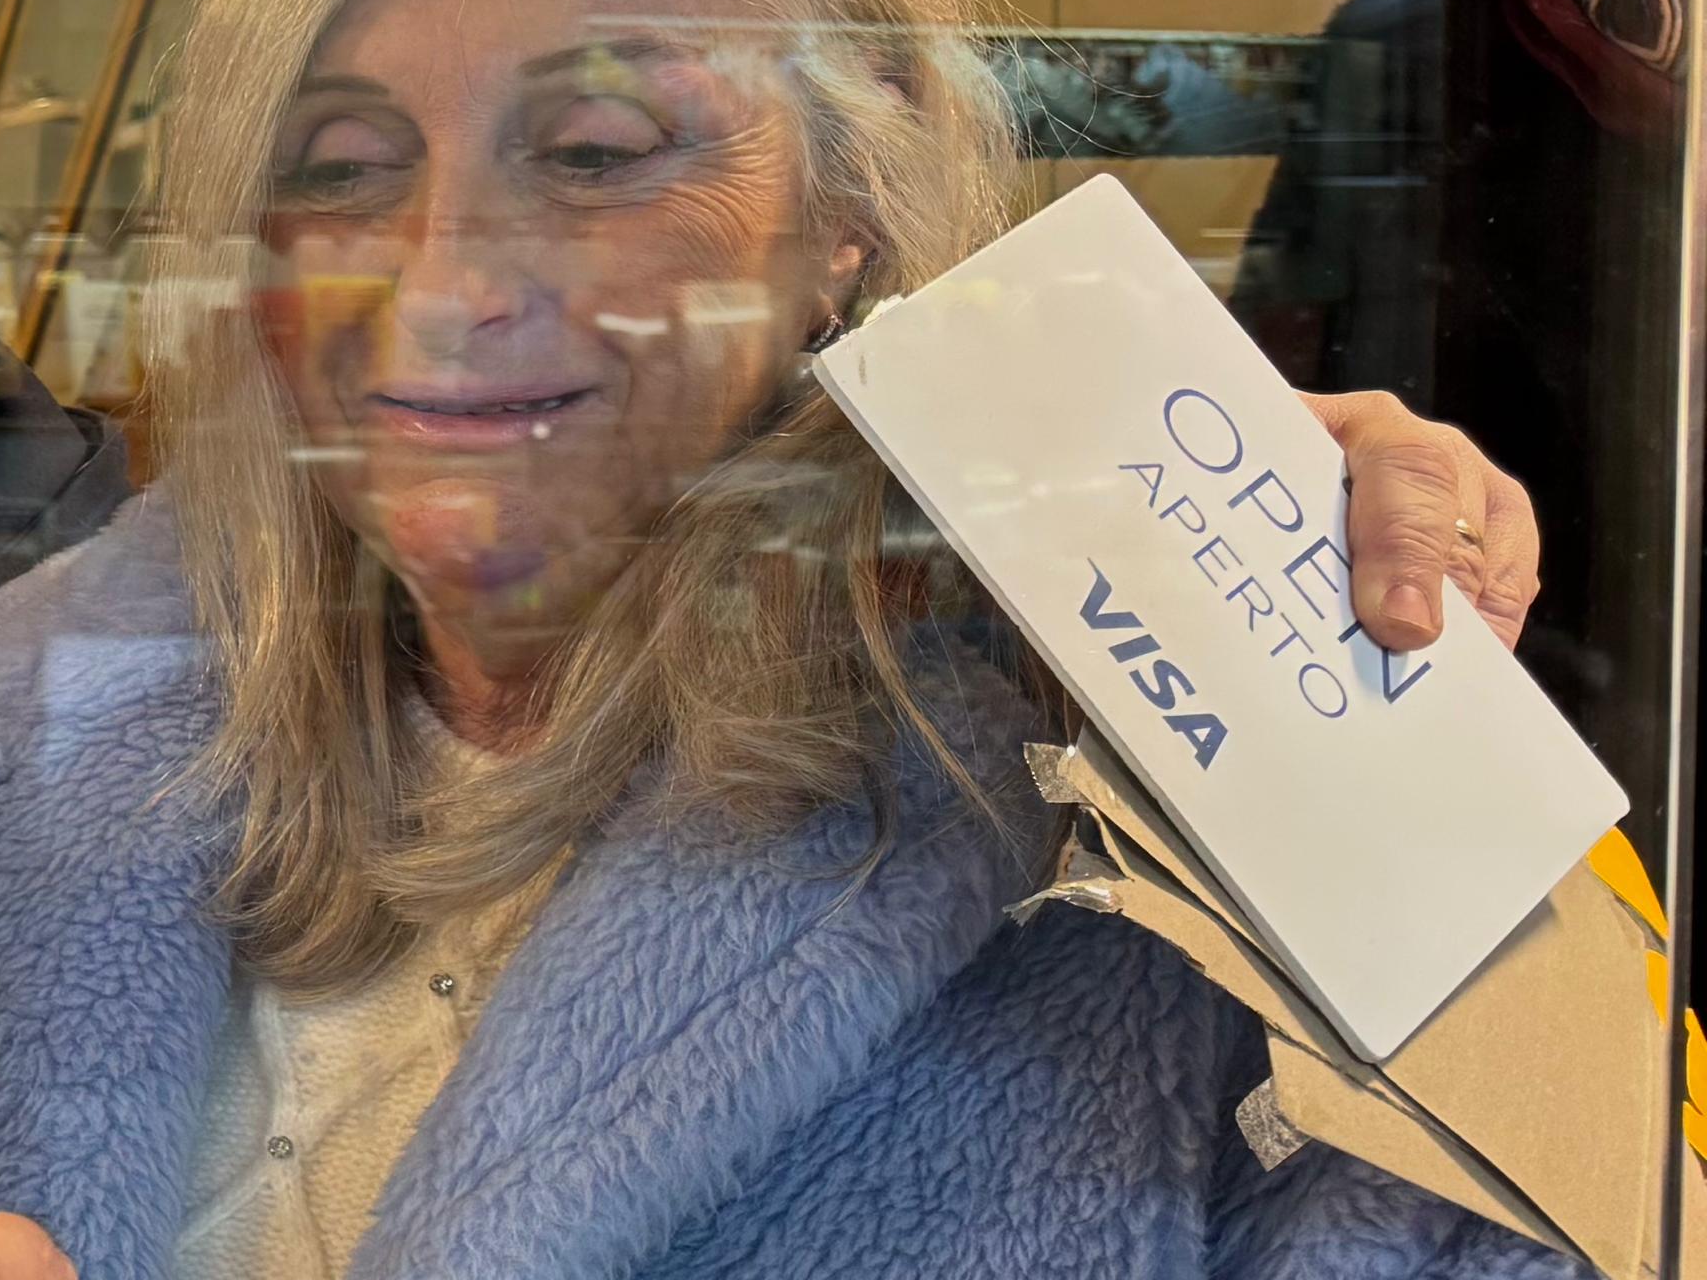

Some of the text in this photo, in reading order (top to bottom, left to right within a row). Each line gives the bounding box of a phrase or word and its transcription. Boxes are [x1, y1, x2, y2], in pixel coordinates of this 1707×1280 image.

[1079, 558, 1229, 771] VISA
[1118, 462, 1349, 718] APERTO
[1163, 388, 1432, 705] OPEN
